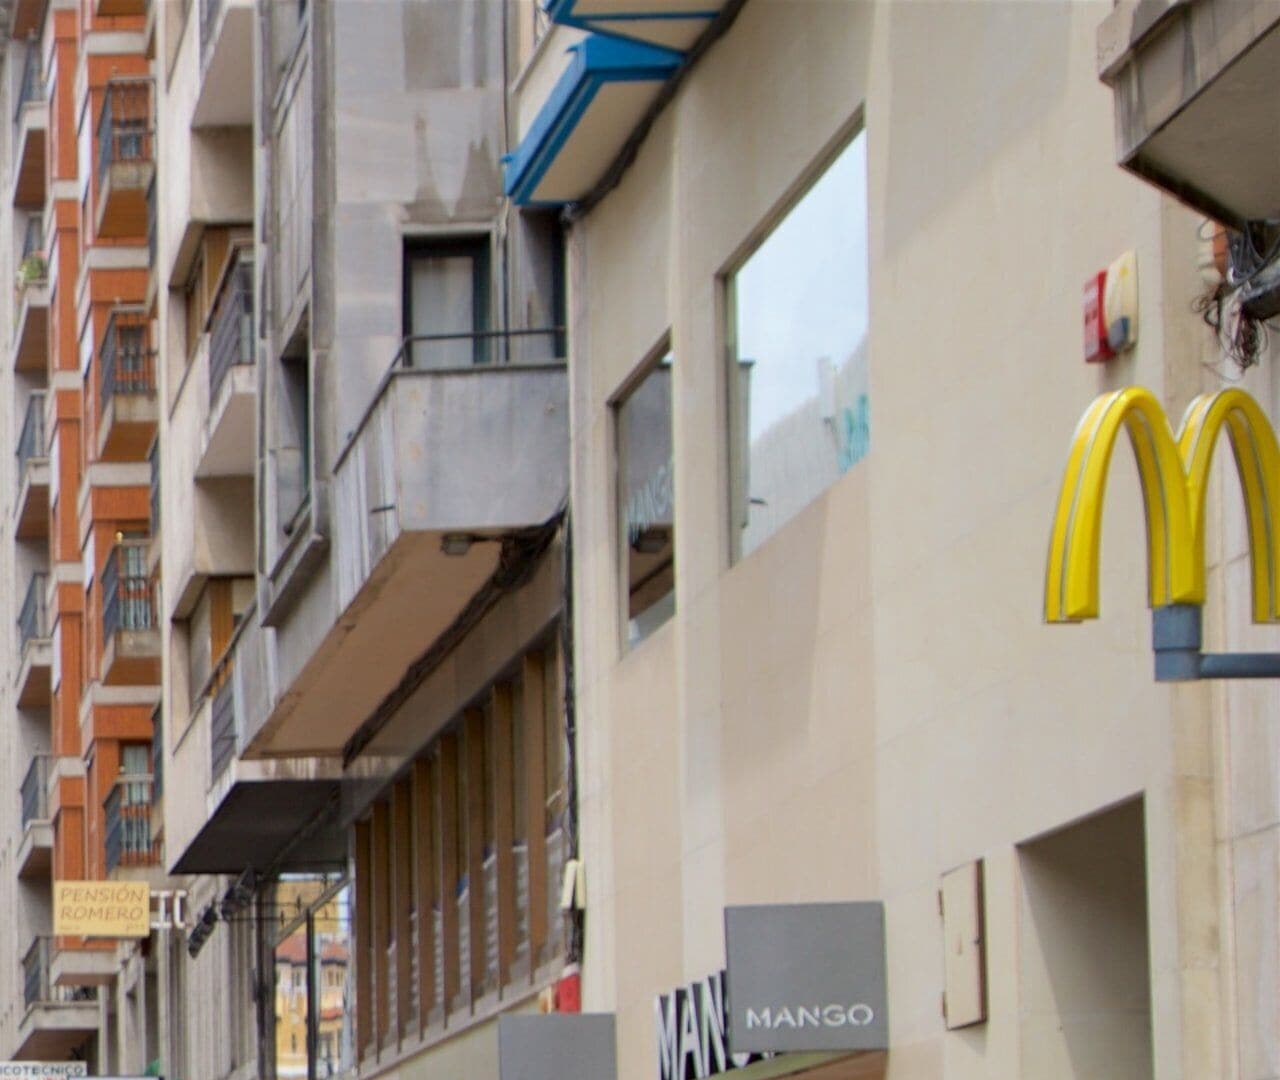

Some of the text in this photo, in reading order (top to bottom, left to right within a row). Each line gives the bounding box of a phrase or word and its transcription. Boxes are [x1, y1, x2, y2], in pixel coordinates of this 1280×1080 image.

[59, 883, 144, 903] PENSIÓN
[59, 904, 144, 921] ROMERO
[746, 1004, 873, 1030] MANGO
